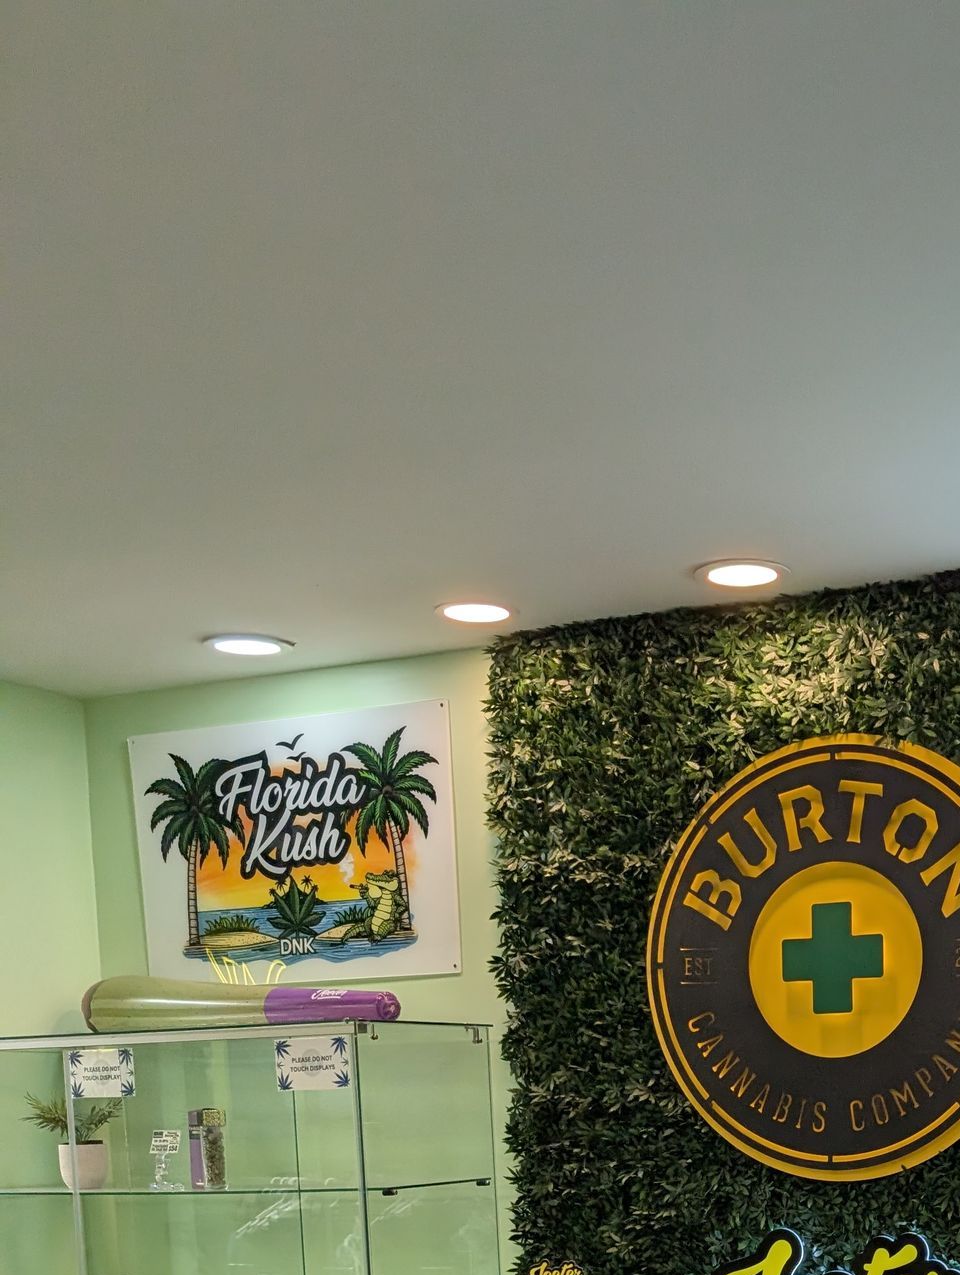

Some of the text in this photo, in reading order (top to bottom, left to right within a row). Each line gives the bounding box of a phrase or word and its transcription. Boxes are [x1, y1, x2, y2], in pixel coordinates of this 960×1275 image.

[215, 759, 366, 823] Florida
[246, 810, 346, 874] Kush
[280, 937, 315, 955] DNK
[684, 957, 713, 977] EST
[290, 1064, 335, 1073] TOUCH DISPLAYS
[291, 1056, 311, 1064] PLEASE
[83, 1074, 121, 1083] TOUCH DISPLAY
[84, 1066, 101, 1074] PLEASE
[110, 1065, 121, 1073] NOT
[688, 1010, 827, 1133] CANNABIS
